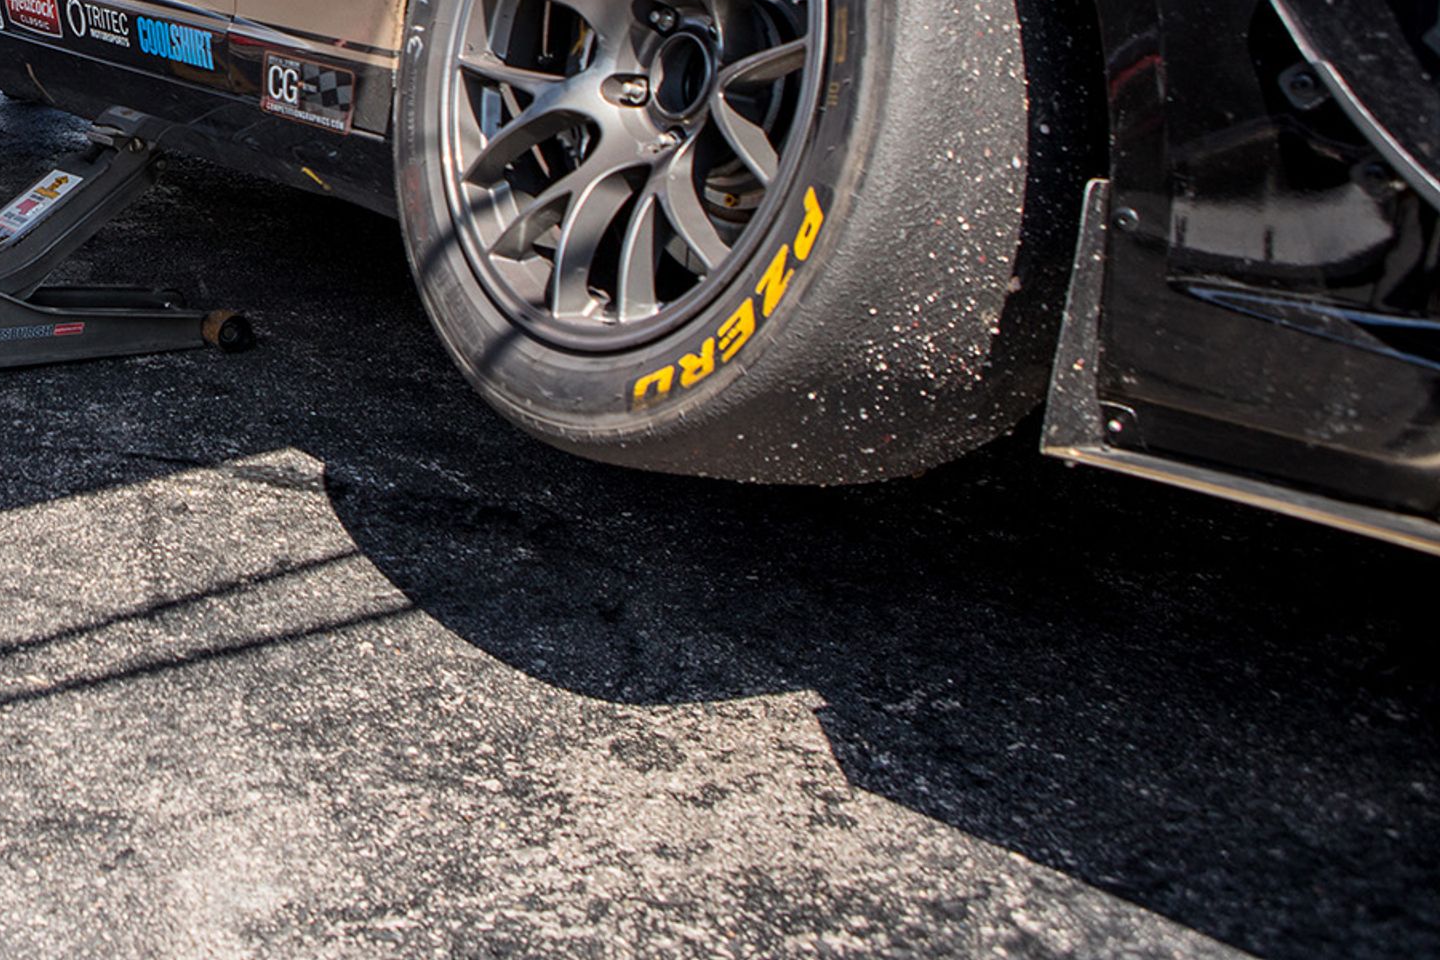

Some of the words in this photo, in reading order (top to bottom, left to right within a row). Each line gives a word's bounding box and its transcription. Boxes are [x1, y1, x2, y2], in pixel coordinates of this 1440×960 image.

[84, 3, 130, 36] TRITEC
[136, 15, 215, 71] COOLSHIRT
[267, 64, 299, 103] CG
